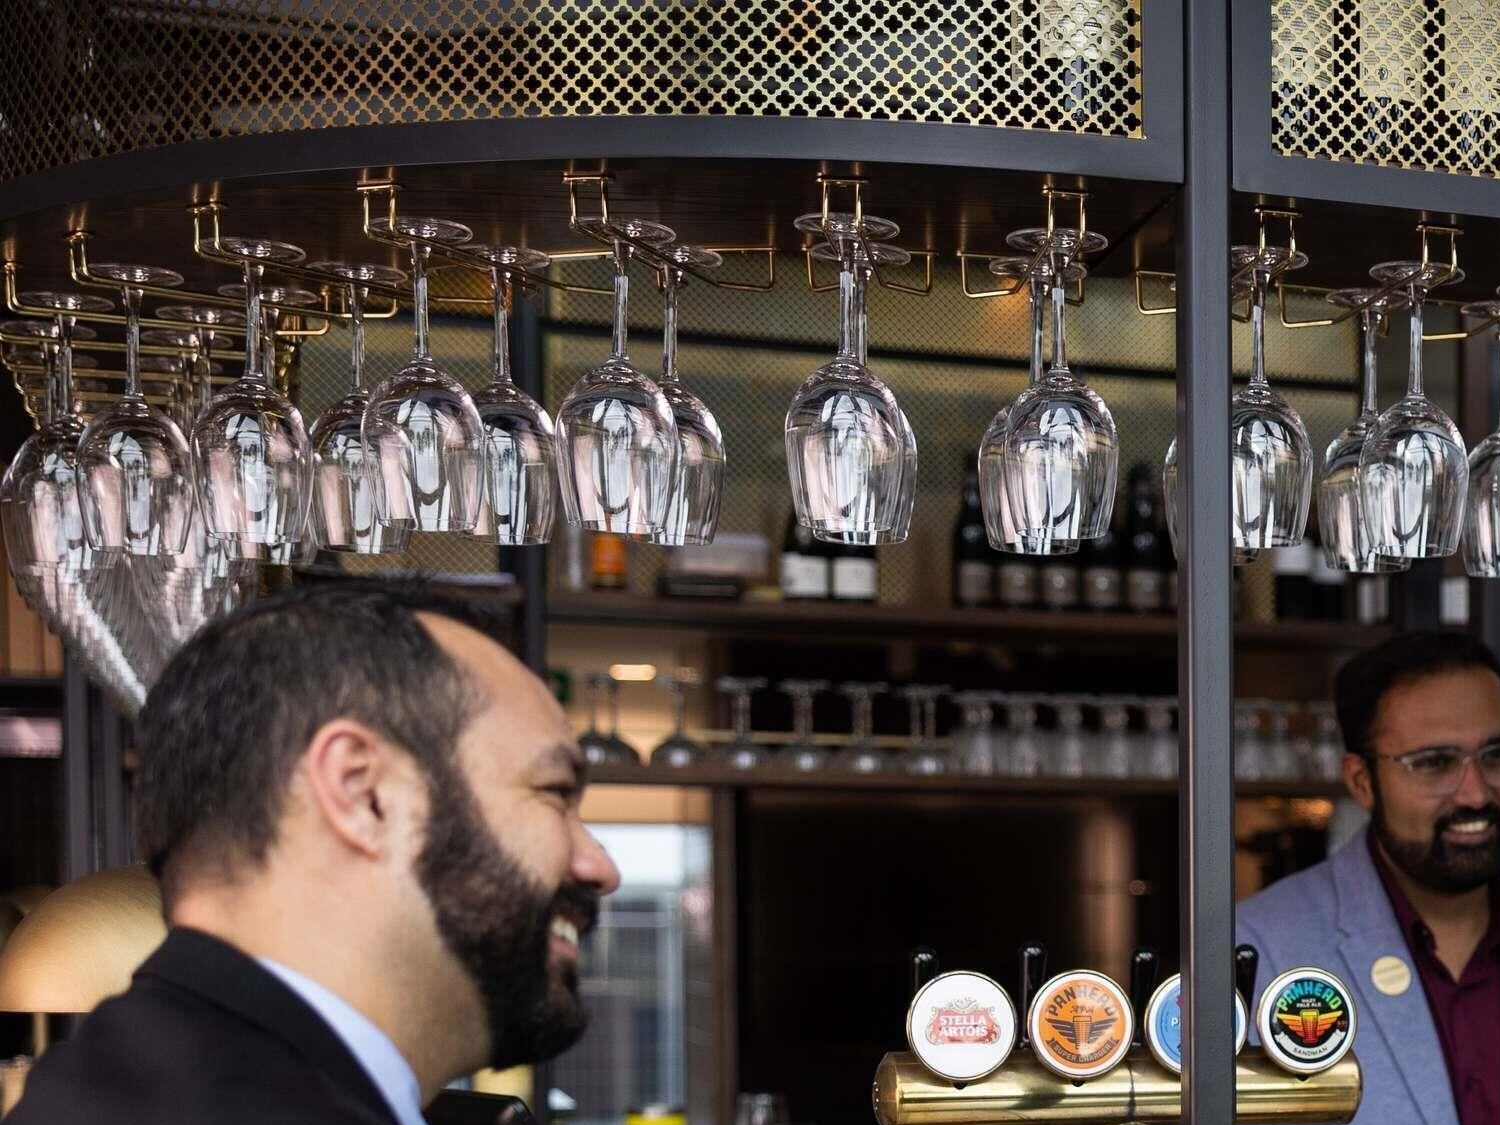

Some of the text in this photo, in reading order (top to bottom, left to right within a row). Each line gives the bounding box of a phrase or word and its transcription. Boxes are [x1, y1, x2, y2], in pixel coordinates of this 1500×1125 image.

[1048, 984, 1117, 1017] PANHEAD
[1277, 981, 1342, 1012] PANHEAD
[939, 1014, 987, 1026] STELLA
[938, 1025, 988, 1037] ARTOIS
[1293, 1046, 1329, 1056] SANDMAN
